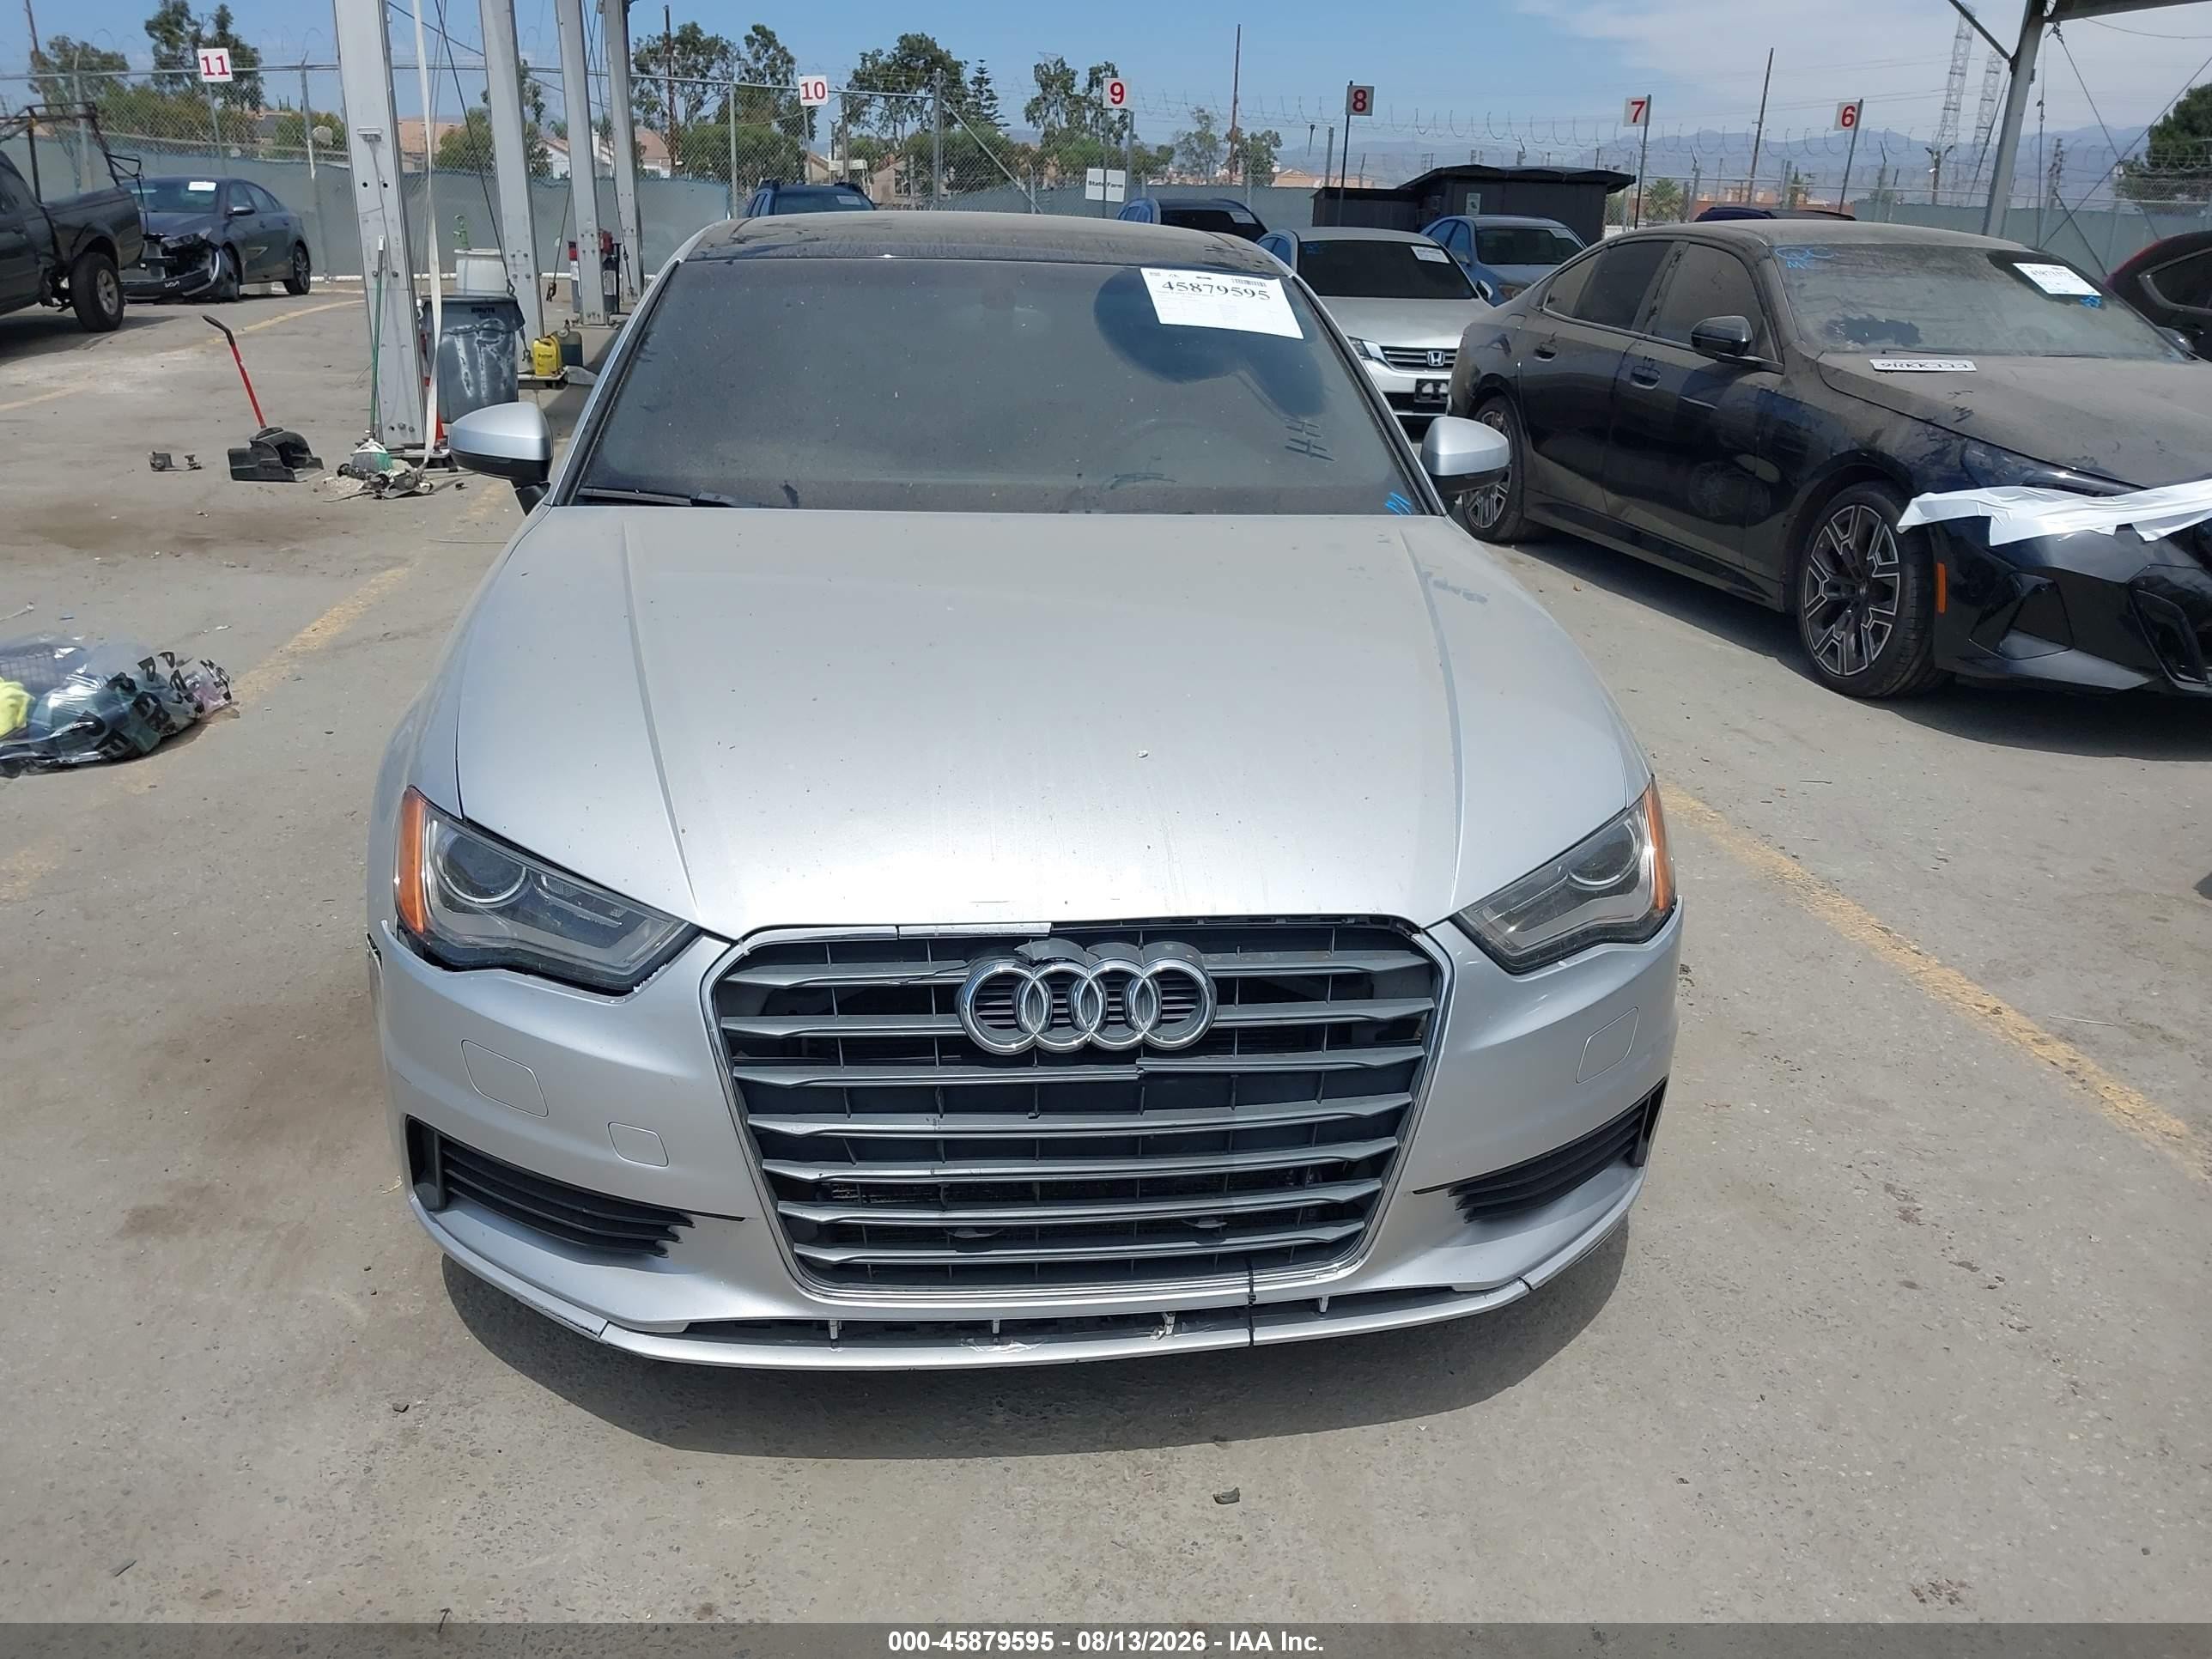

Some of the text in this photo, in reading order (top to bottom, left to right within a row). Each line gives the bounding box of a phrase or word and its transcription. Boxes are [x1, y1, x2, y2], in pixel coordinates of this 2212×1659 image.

[201, 55, 230, 76] 11
[800, 81, 826, 100] 10
[1109, 82, 1125, 105] 9
[1352, 88, 1367, 112] 8
[1631, 100, 1645, 124] 7
[1841, 105, 1856, 128] 6
[1161, 281, 1271, 301] 45879595
